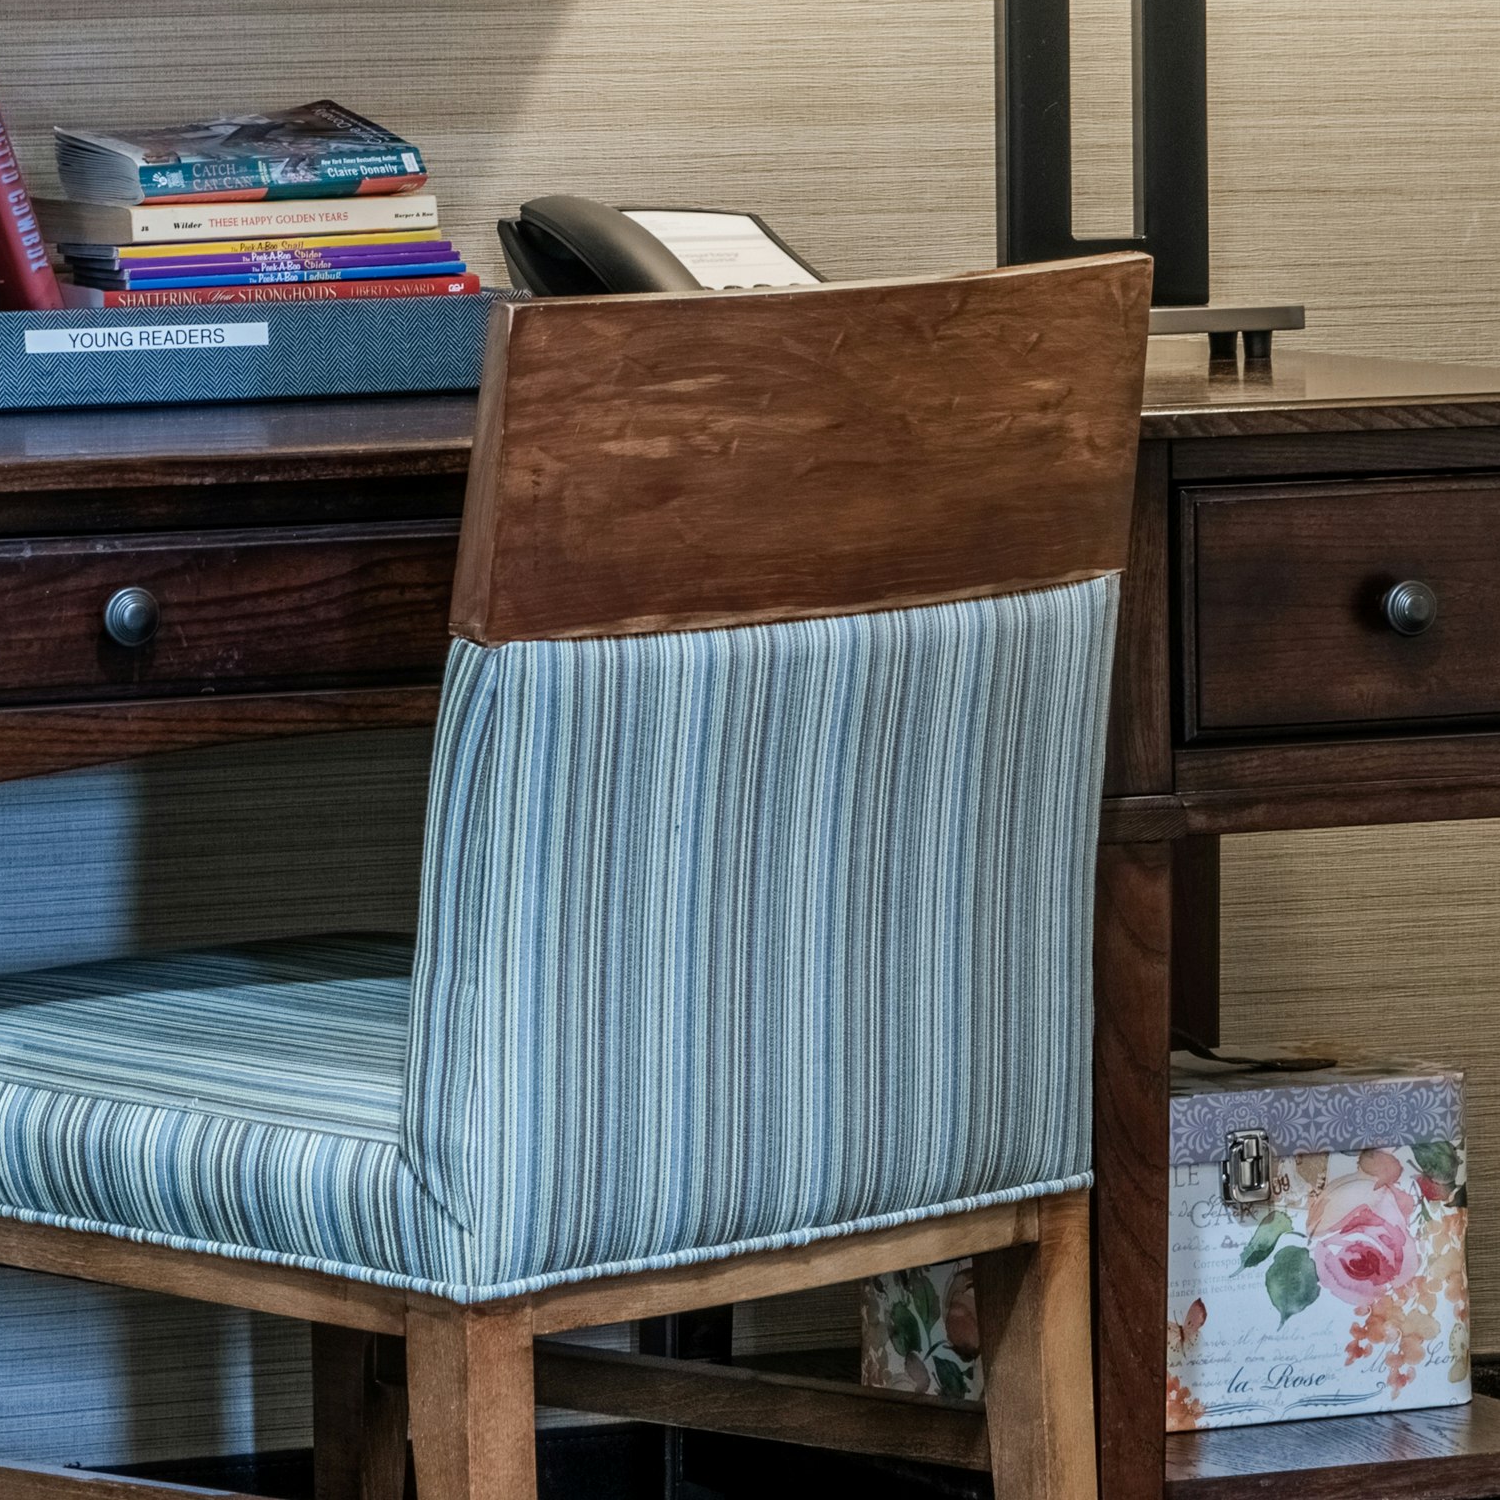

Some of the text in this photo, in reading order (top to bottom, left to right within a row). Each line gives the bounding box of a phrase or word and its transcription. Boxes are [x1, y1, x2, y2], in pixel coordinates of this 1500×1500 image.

[356, 156, 381, 164] Bestselling
[192, 163, 236, 178] CATCH
[327, 165, 358, 178] Claire
[361, 163, 398, 176] Donally
[173, 211, 349, 230] Wilder THESE HAPPY GOLDEN YEARS
[240, 240, 304, 252] Peek-A-Boo Snail
[251, 251, 291, 262] Peek-A-Boo
[258, 273, 298, 283] Peek-A-Boo
[118, 283, 435, 306] SHATTERING STRONGHOLDS LIBERTY SAVARD
[68, 328, 225, 349] YOUNG READERS
[1173, 1163, 1200, 1188] LE
[1227, 1366, 1254, 1395] la
[1260, 1363, 1327, 1391] Rose
